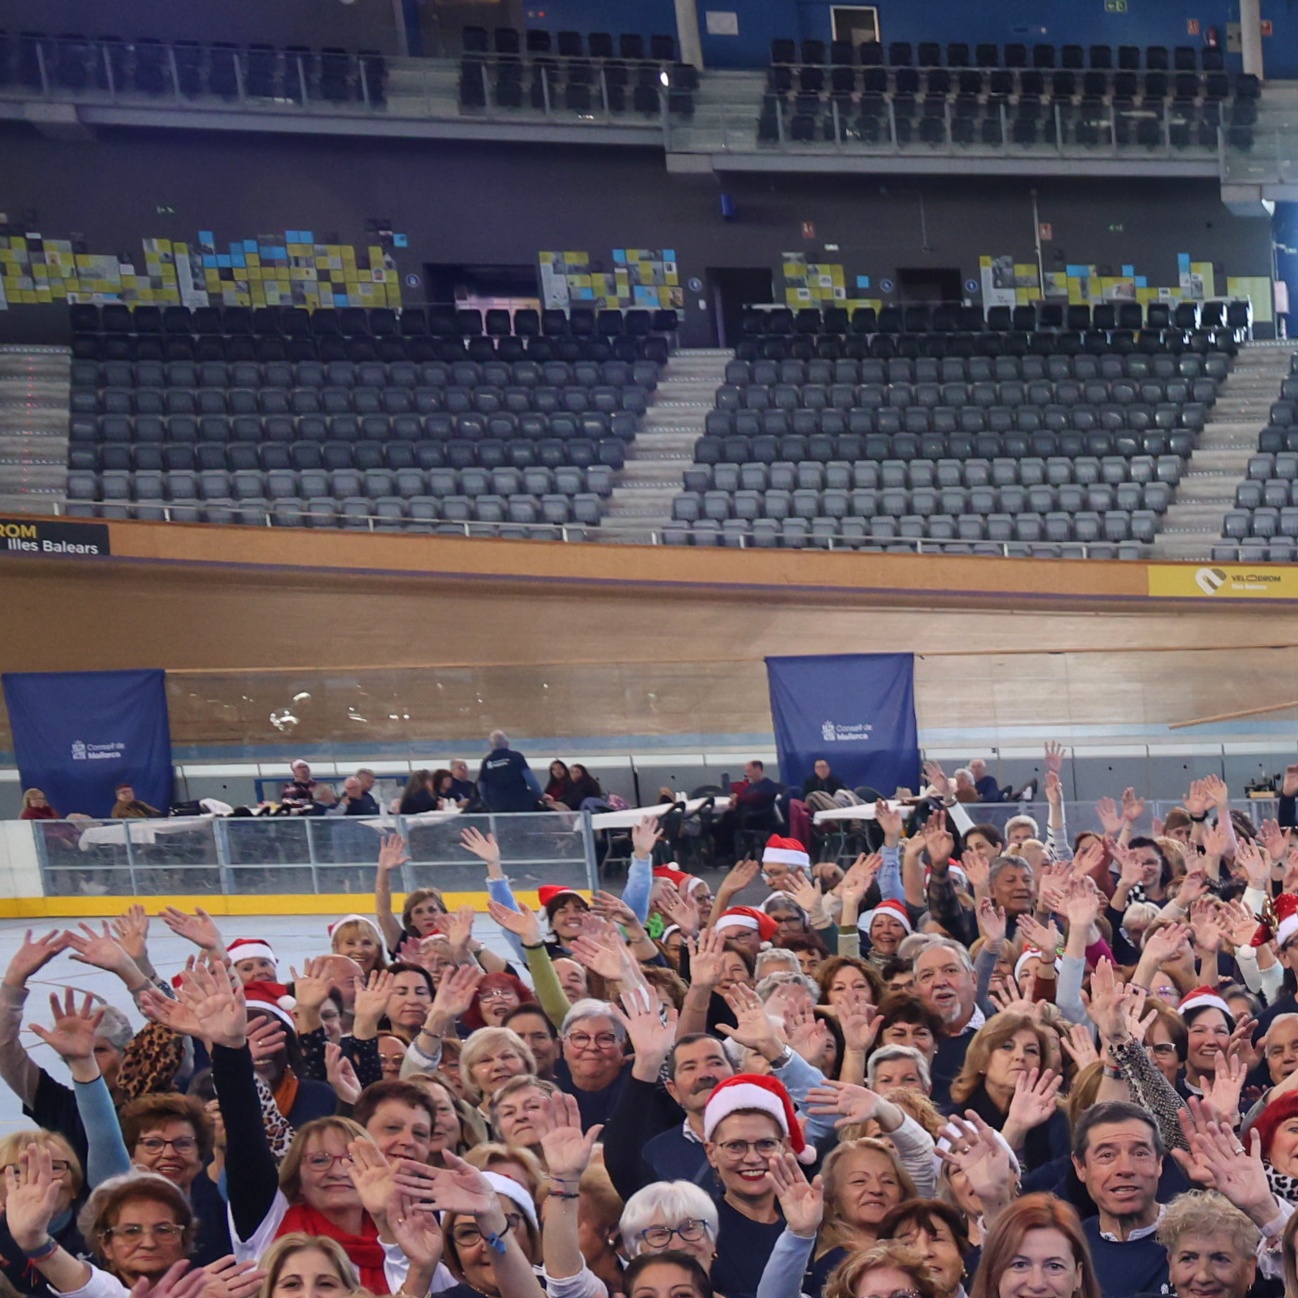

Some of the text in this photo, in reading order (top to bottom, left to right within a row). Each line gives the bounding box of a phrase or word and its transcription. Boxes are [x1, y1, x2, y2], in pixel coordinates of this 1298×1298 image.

[7, 538, 99, 554] Illes Balears
[836, 732, 869, 741] Mallorca
[87, 742, 115, 752] Consell
[87, 752, 121, 760] Mallorca
